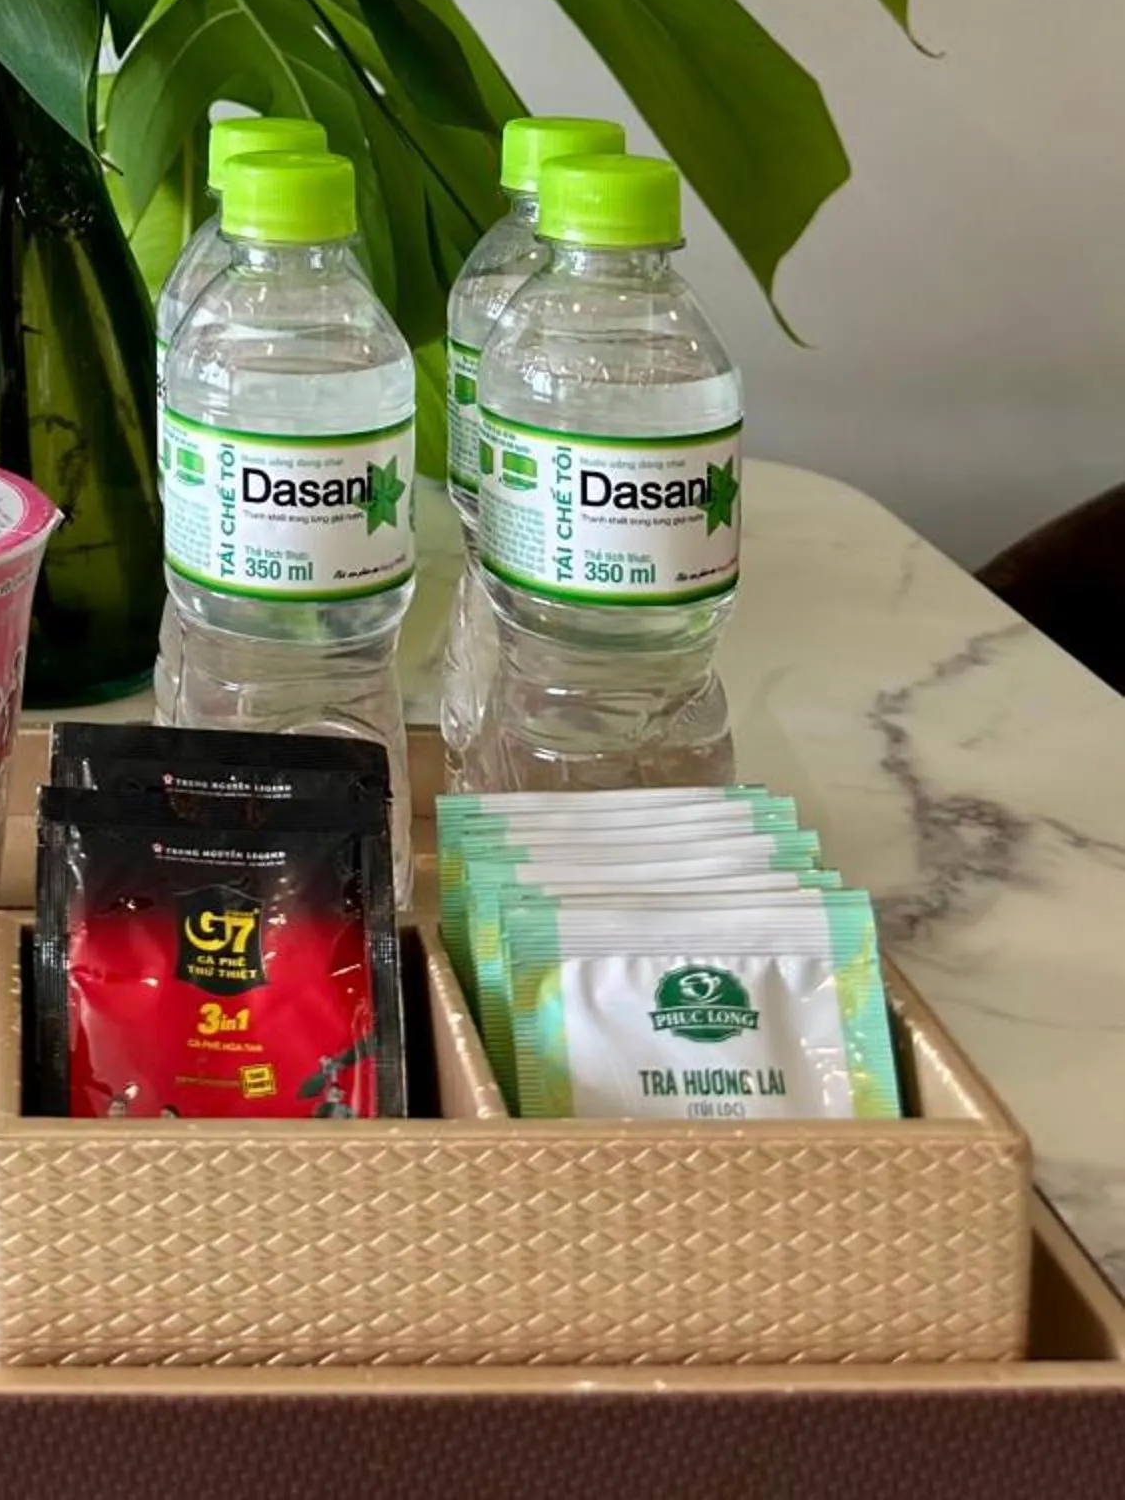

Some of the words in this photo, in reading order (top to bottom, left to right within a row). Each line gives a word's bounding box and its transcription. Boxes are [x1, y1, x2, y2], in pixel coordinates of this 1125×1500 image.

[241, 461, 374, 509] Dasani
[579, 462, 712, 511] Dasani
[245, 557, 282, 580] 350
[288, 561, 314, 581] ml
[584, 560, 624, 583] 350
[630, 563, 656, 584] ml
[184, 909, 255, 954] G7
[196, 1002, 251, 1035] 3in1
[706, 1009, 756, 1028] LONG
